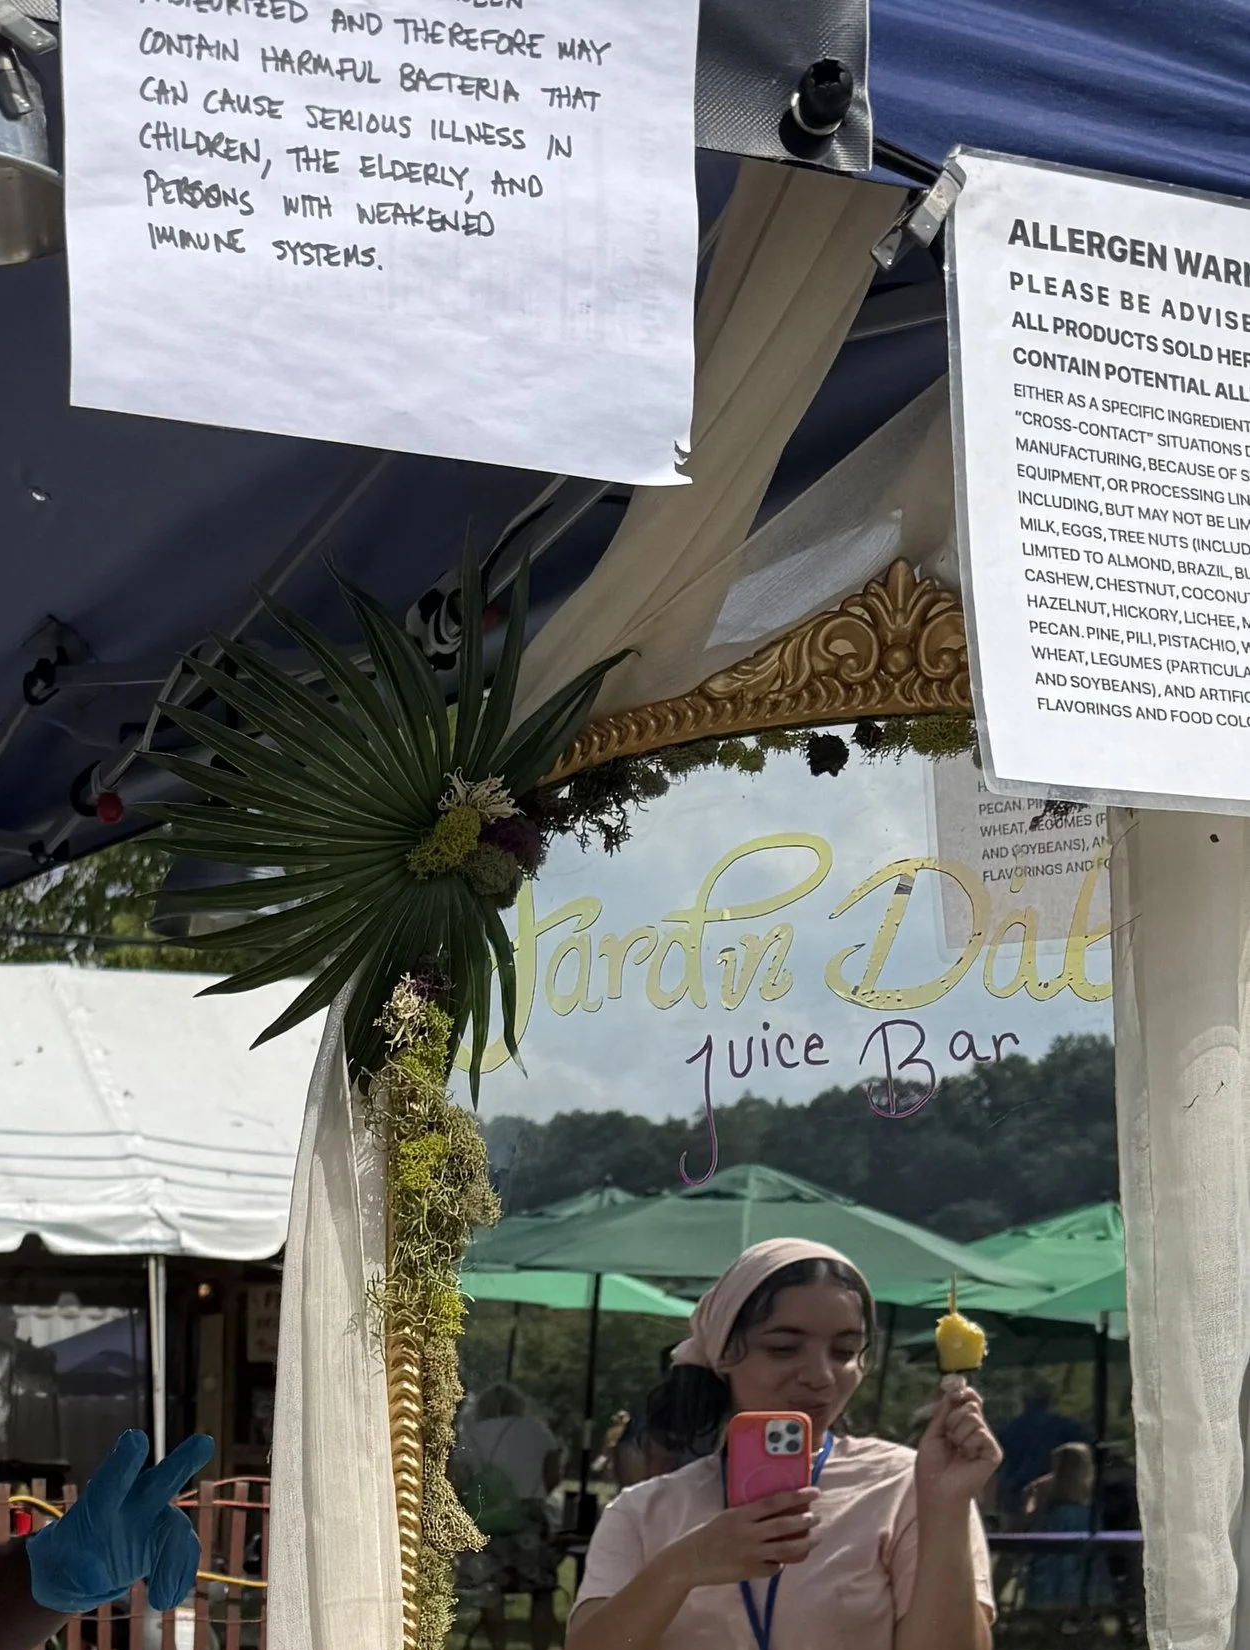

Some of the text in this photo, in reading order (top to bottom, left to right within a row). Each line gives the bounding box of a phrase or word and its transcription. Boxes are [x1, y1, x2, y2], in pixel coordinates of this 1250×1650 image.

[331, 8, 613, 66] AND THEREFORE MAY
[138, 26, 602, 113] CONTAIN HARMFUL BACTERIA THAT
[138, 75, 573, 161] CAN CAUSE SERIOUS ILLNESS IN
[138, 119, 544, 206] CHILDREN, THE ELDERLY, AND
[281, 193, 333, 221] WITH
[355, 201, 496, 238] WEAKENED
[146, 221, 384, 272] IMMUNE SYSTEMS.
[1007, 217, 1168, 273] ALLERGEN
[1009, 270, 1151, 315] PLEASE BE
[1010, 310, 1214, 362] ALL PRODUCTS SOLD
[1012, 346, 1212, 398] CONTAIN POTENTIAL
[1013, 382, 1166, 422] EITHER SPECIFIC
[1015, 436, 1217, 479] MANUFACTURING, BECAUSE
[1156, 432, 1243, 457] SITUATIONS
[1016, 462, 1226, 505] EQUIPMENT, PROCESSING
[1017, 489, 1204, 527] INCLUDING, BUT MAY NOT
[1019, 515, 1190, 550] MILK, EGGS, TREE NUTS
[1021, 541, 1234, 582] LIMITED ALMOND, BRAZIL,
[1023, 567, 1180, 601] CASHEW, CHESTNUT,
[1026, 593, 1241, 632] HAZELNUT, HICKORY, LICHEE,
[1030, 644, 1163, 672] WHEAT, LEGUMES
[1085, 625, 1125, 646] PINE,
[1125, 629, 1157, 649] PILI,
[1157, 632, 1240, 656] PISTACHIO,
[1034, 671, 1068, 688] AND
[1163, 683, 1197, 700] AND
[1036, 696, 1214, 726] FLAVORINGS AND FOOD
[859, 1018, 1020, 1119] Bar
